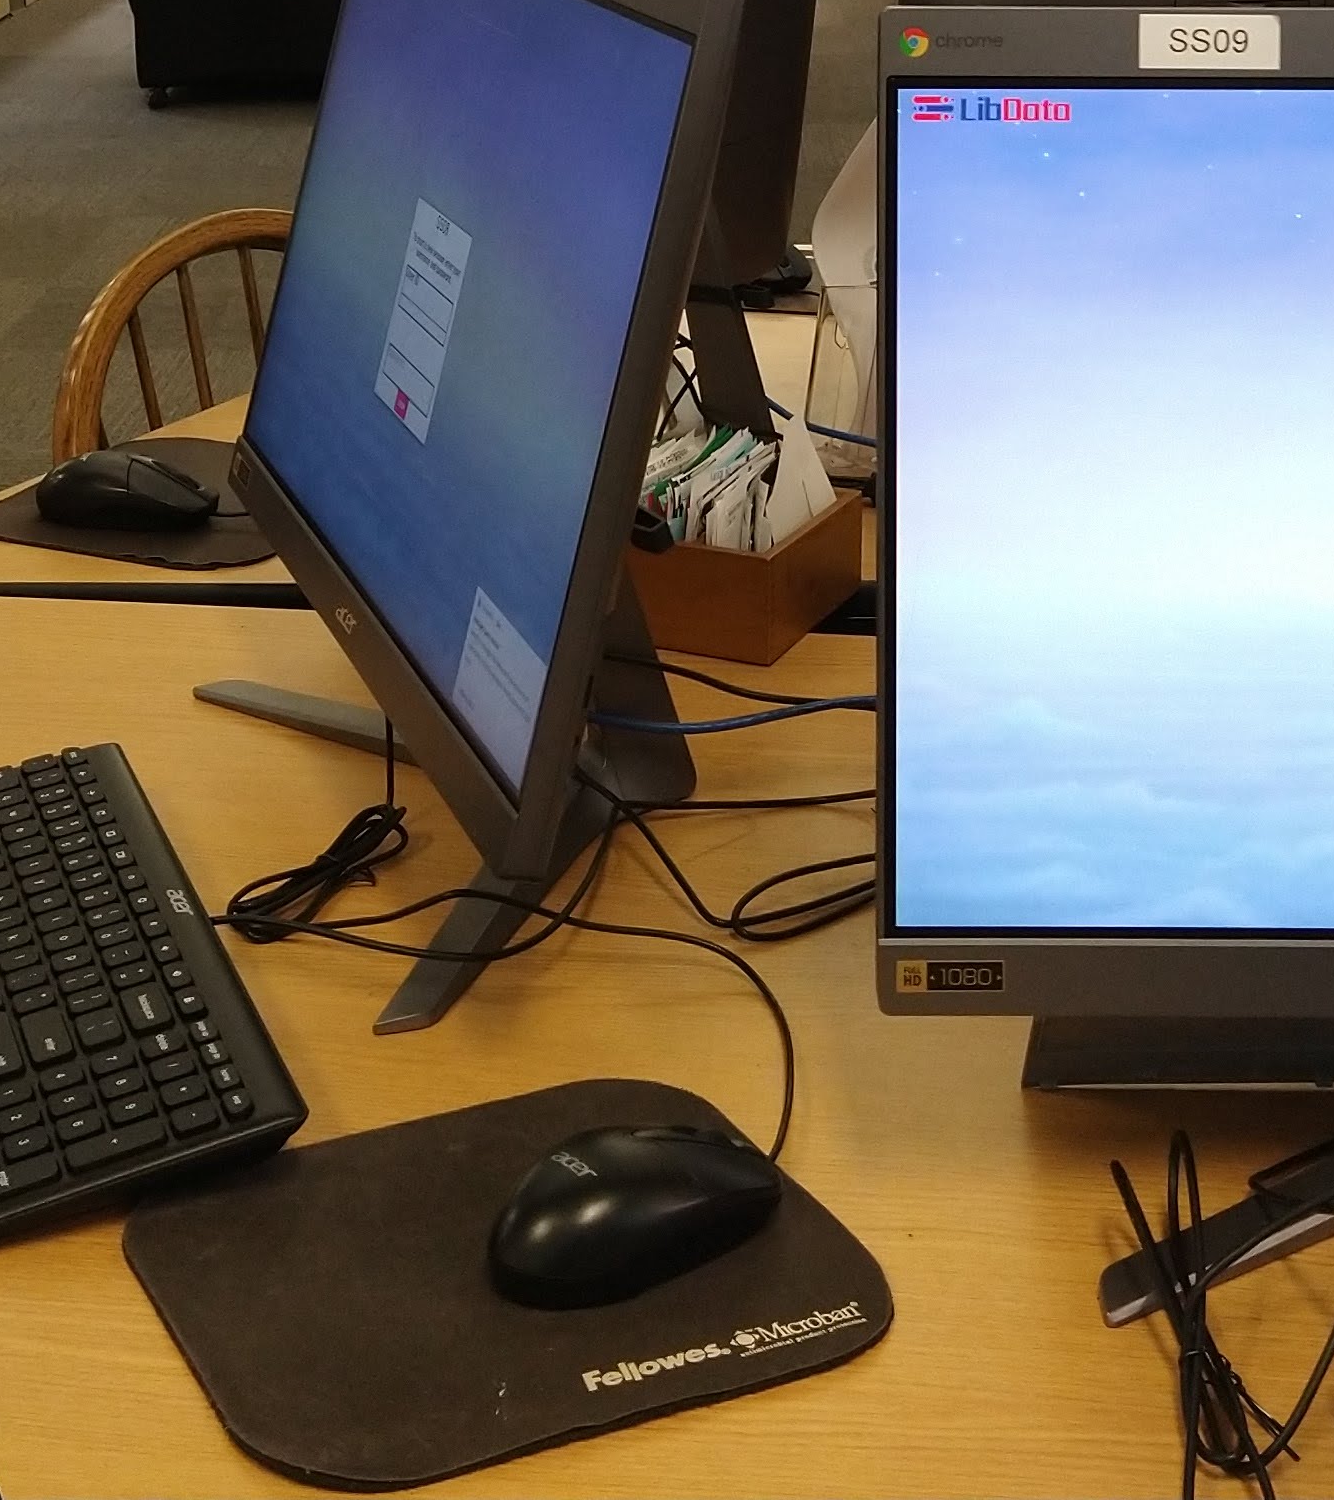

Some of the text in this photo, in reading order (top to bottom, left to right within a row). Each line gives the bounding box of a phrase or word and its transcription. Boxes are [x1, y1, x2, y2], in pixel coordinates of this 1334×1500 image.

[934, 32, 1004, 49] chrome
[1168, 28, 1249, 54] SS09
[166, 889, 193, 916] acer
[903, 966, 922, 974] FULL
[940, 968, 993, 986] 1080
[903, 975, 922, 987] HD
[551, 1151, 598, 1179] acer
